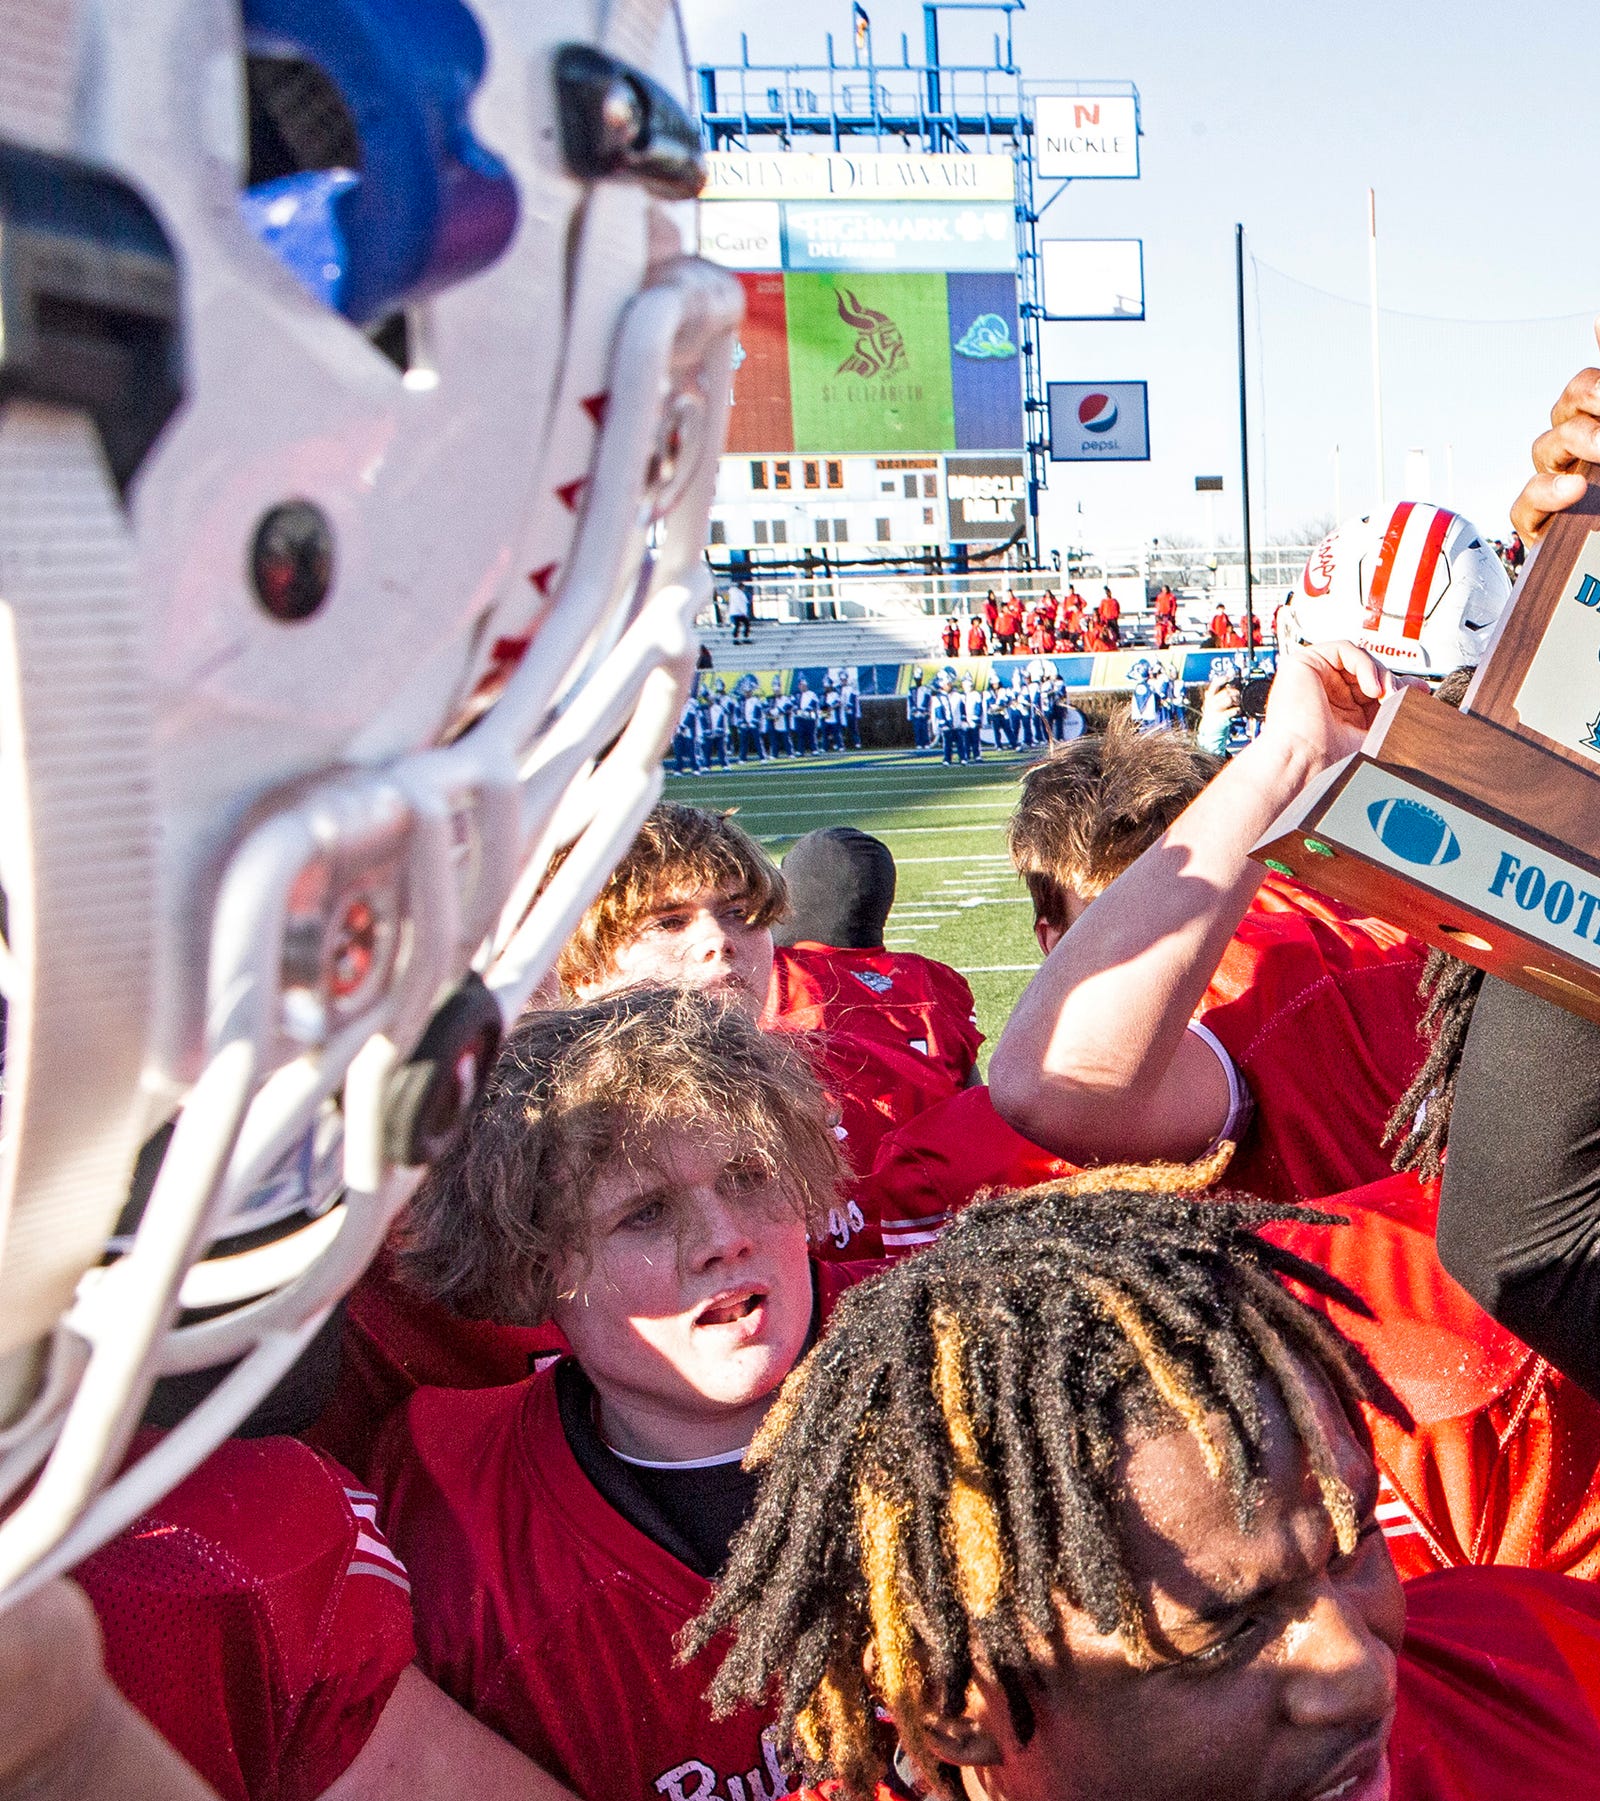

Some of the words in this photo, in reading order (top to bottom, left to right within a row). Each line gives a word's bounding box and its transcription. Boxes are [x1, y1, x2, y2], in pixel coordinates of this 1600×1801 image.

[1047, 136, 1128, 153] NICKLE
[827, 157, 978, 193] DELAWARE
[1081, 440, 1119, 453] pepsi
